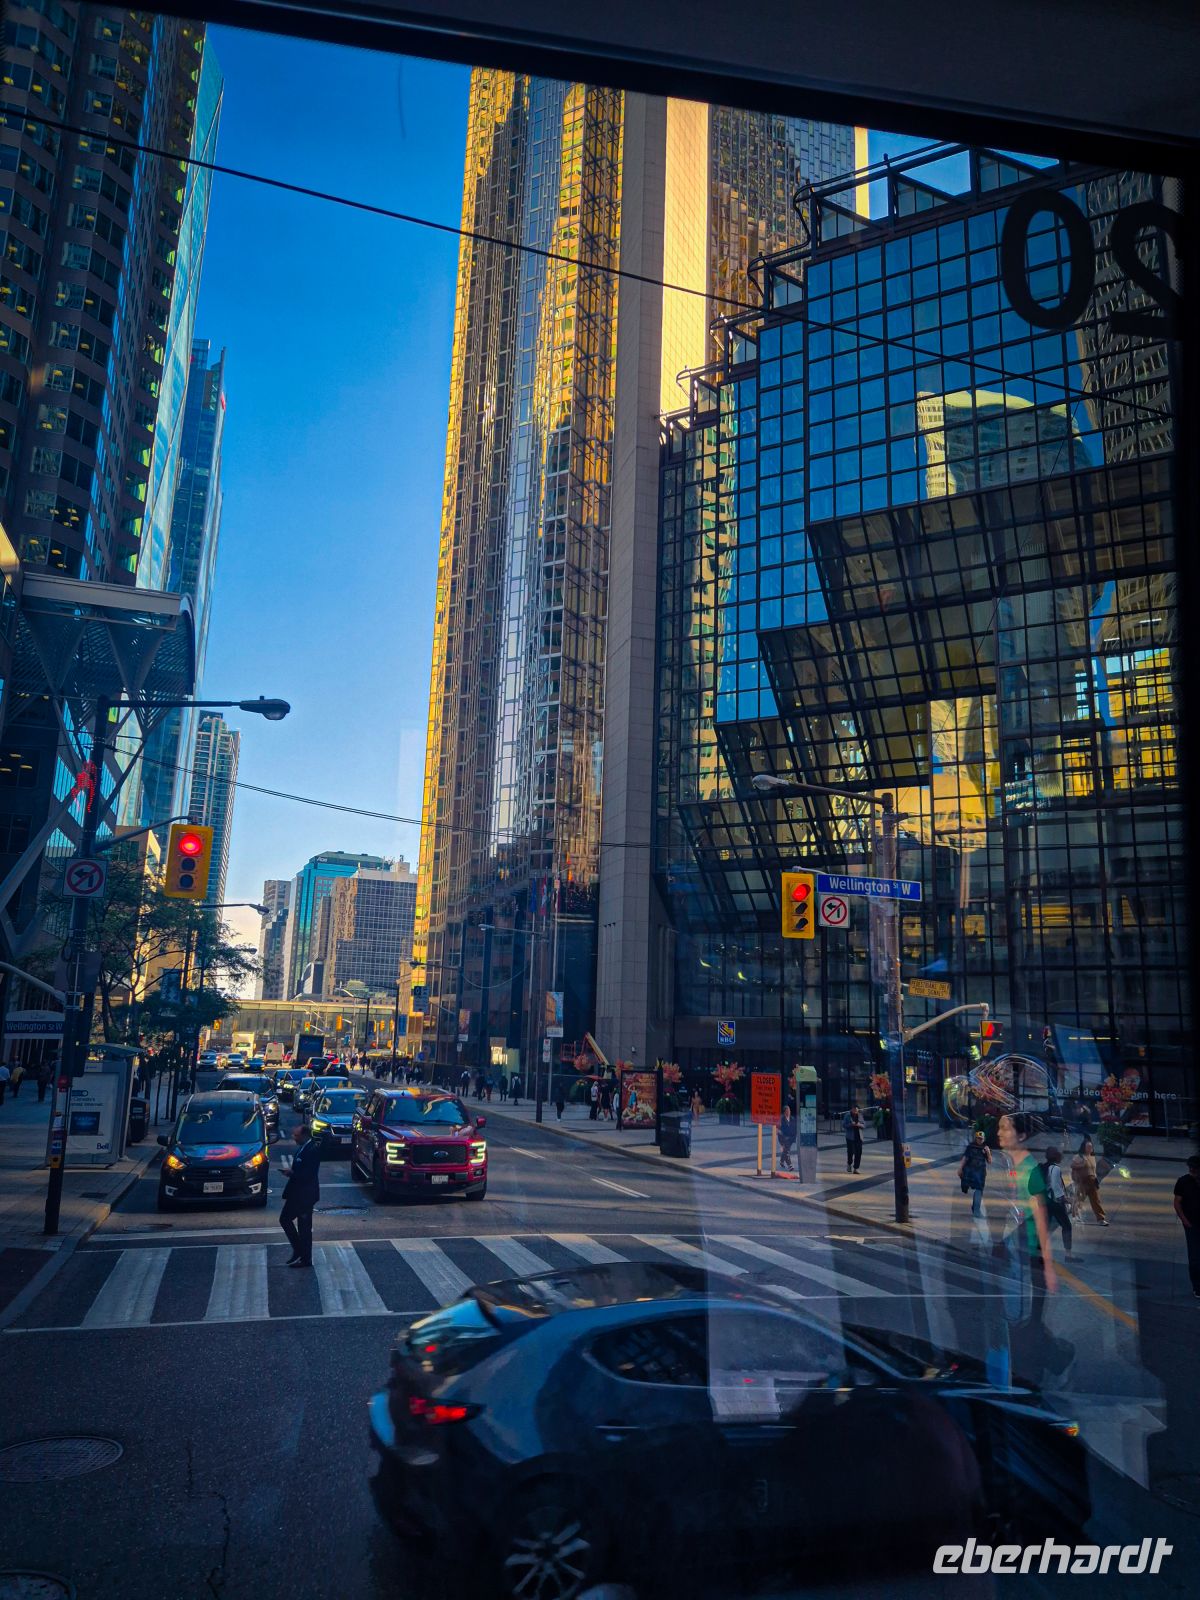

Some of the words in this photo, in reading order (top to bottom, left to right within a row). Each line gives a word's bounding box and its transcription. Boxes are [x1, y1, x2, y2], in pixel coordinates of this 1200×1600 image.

[829, 877, 890, 894] Wellington
[901, 883, 911, 895] W
[6, 1022, 47, 1033] Wellington
[1055, 1087, 1072, 1096] Your
[1154, 1090, 1177, 1100] here
[96, 1142, 109, 1150] Bell
